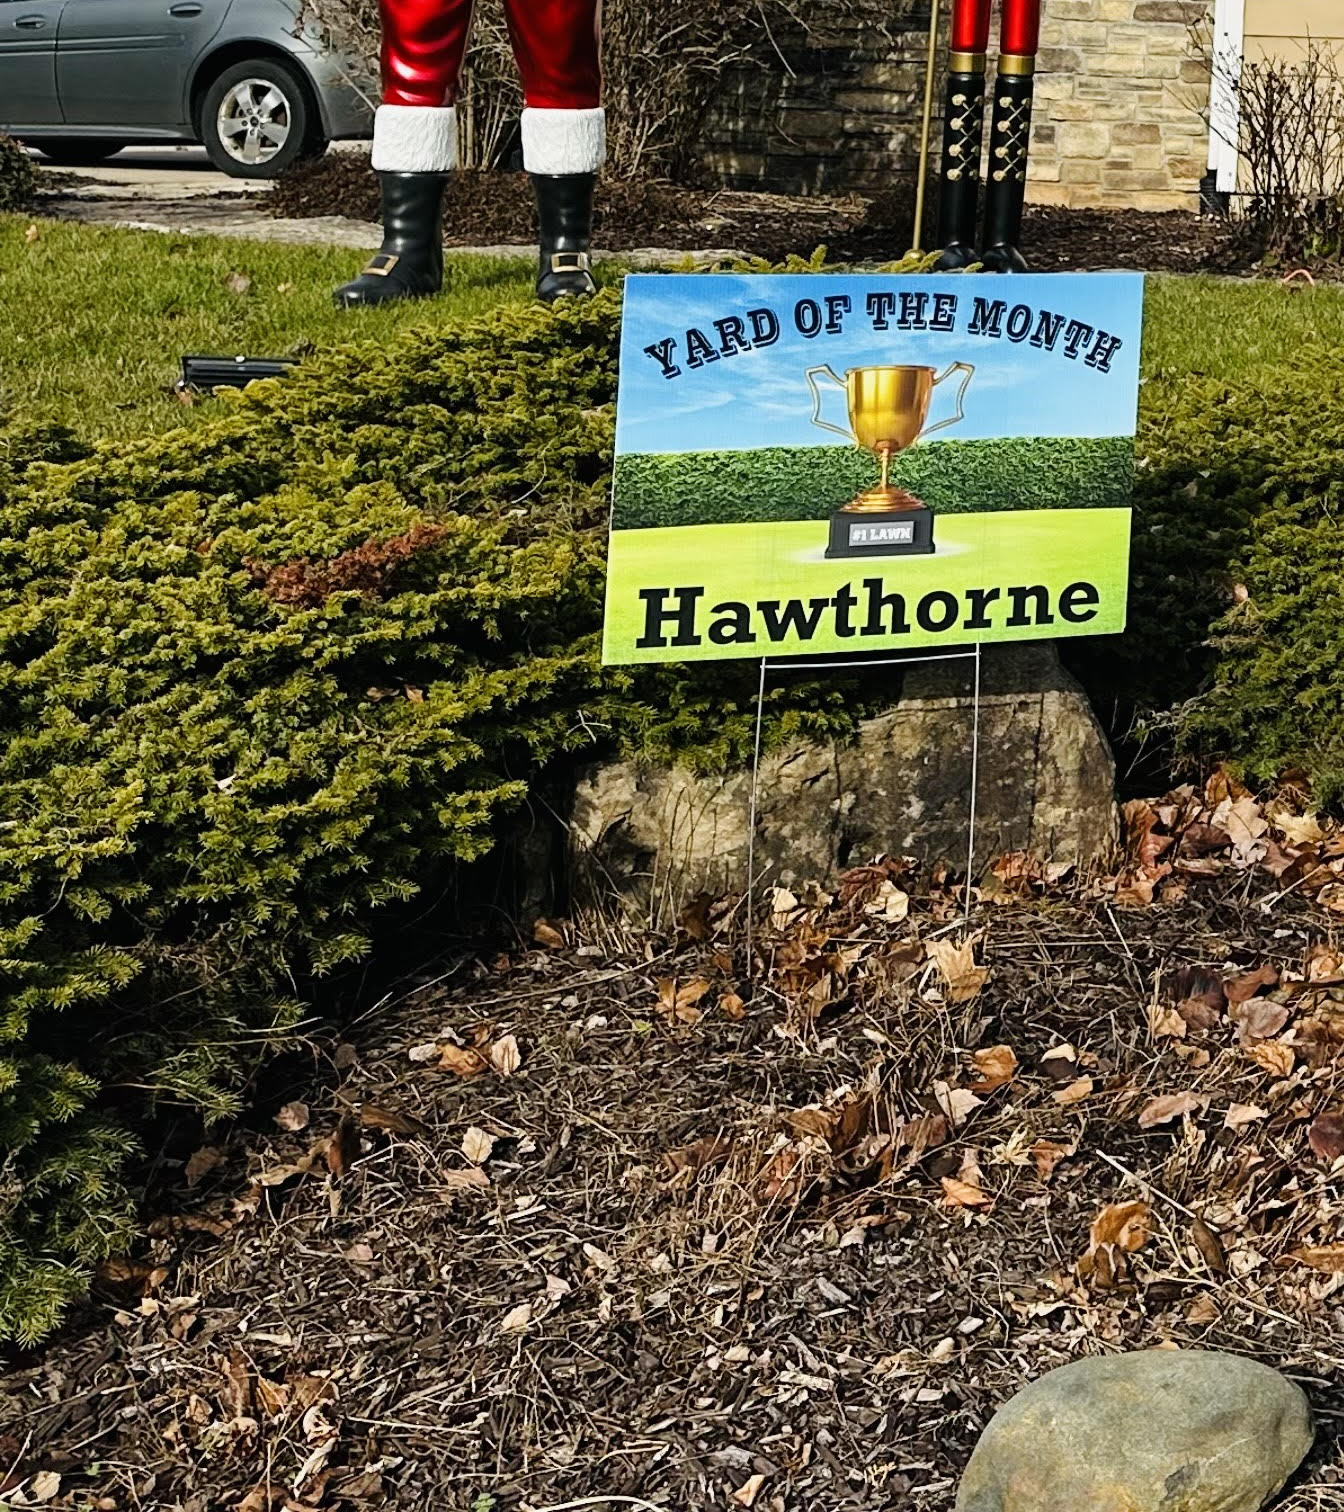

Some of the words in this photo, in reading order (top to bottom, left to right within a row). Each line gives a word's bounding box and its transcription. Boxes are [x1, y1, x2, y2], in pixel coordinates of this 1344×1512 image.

[643, 308, 780, 380] YARD
[794, 294, 852, 338] OF
[866, 292, 957, 332] THE
[967, 296, 1122, 374] MONTH
[852, 528, 867, 542] #1
[869, 527, 911, 541] LAWN
[635, 577, 1100, 649] Hawthorne
